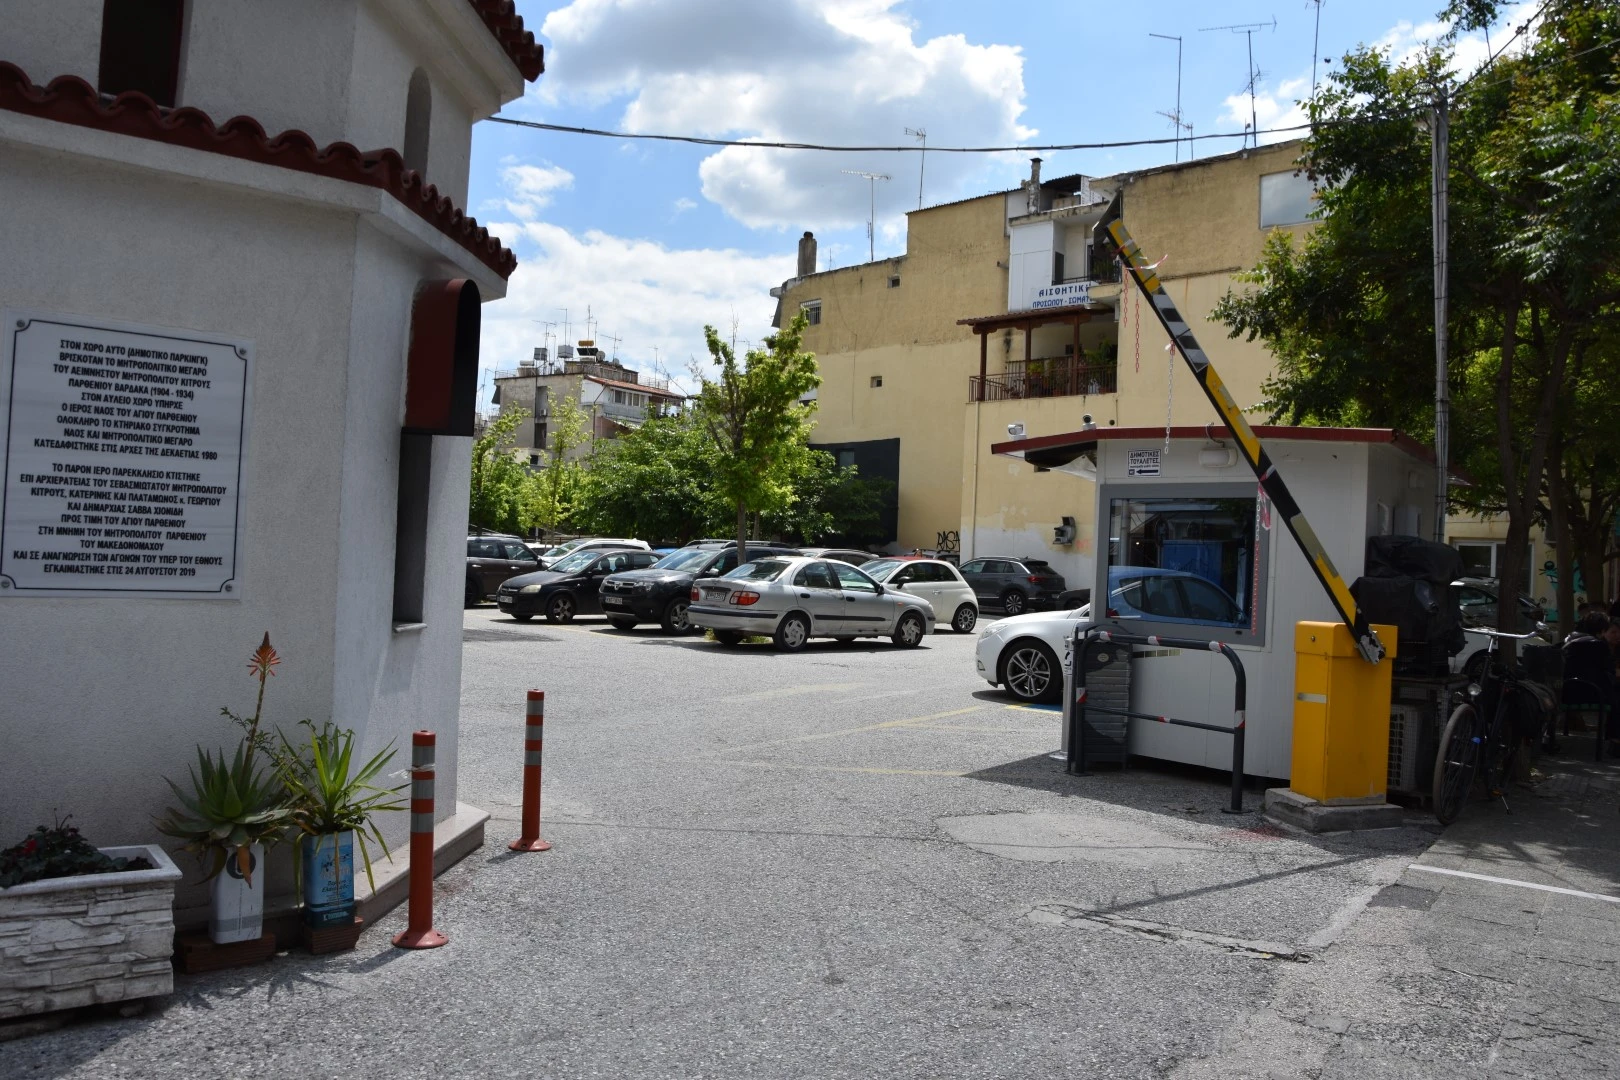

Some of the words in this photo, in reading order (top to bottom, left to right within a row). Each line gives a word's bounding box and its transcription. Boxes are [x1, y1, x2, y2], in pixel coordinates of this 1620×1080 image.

[1033, 298, 1063, 308] ΠΡΟΣΩΠΟΥ
[1068, 296, 1092, 305] ΣΩΜΑΤ
[60, 339, 82, 350] ΣΤΟΝ
[82, 342, 104, 352] ΧΩΡΟ
[105, 345, 126, 355] ΑΥΤΟ
[127, 347, 169, 360] (ΔΗΜΟΤΙΚΟ
[170, 352, 208, 365] ΠΑΡΚΙΝΓΚ)
[59, 352, 104, 365] ΒΡΙΣΚΟΤΑΝ
[105, 357, 116, 366] ΤΟ
[116, 358, 178, 373] ΜΗΤΡΟΠΟΛΙΤΙΚΟ
[178, 365, 207, 376] ΜΕΓΑΡΟ
[53, 364, 69, 374] ΤΟΥ
[70, 366, 120, 379] ΑΕΙΜΝΗΣΤΟΥ
[122, 371, 179, 385] ΜΗΤΡΟΠΟΛΙΤΟΥ
[180, 378, 211, 389] ΚΙΤΡΟΥΣ
[68, 378, 112, 390] ΠΑΡΘΕΝΙΟΥ
[114, 383, 149, 394] ΒΑΡΔΑΚΑ
[150, 387, 170, 396] (1904
[176, 389, 194, 399] 1934)
[81, 392, 102, 402] ΣΤΟΝ
[103, 394, 132, 405] ΑΥΛΕΙΟ
[132, 397, 153, 406] ΧΩΡΟ
[154, 399, 183, 409] ΥΠΗΡΧΕ
[61, 403, 68, 411] Ο
[69, 403, 92, 414] ΙΕΡΟΣ
[93, 405, 115, 416] ΝΑΟΣ
[116, 408, 131, 417] ΤΟΥ
[133, 409, 154, 419] ΑΓΙΟΥ
[156, 412, 197, 423] ΠΑΡΘΕΝΙΟΥ
[56, 415, 100, 426] ΟΛΟΚΛΗΡΟ
[102, 419, 112, 427] ΤΟ
[113, 420, 151, 431] ΚΤΗΡΙΑΚΟ
[152, 423, 200, 435] ΣΥΓΚΡΟΤΗΜΑ
[63, 428, 85, 438] ΝΑΟΣ
[86, 430, 100, 439] ΚΑΙ
[101, 431, 163, 444] ΜΗΤΡΟΠΟΛΙΤΙΚΟ
[164, 436, 193, 446] ΜΕΓΑΡΟ
[34, 438, 99, 451] ΚΑΤΕΔΑΦΙΣΤΗΚΕ
[101, 443, 118, 453] ΣΤΙΣ
[119, 445, 143, 455] ΑΡΧΕΣ
[145, 446, 159, 456] ΤΗΣ
[160, 448, 200, 458] ΔΕΚΑΕΤΙΑΣ
[201, 451, 218, 460] 1980
[52, 463, 63, 472] ΤΟ
[64, 464, 92, 474] ΠΑΡΟΝ
[93, 466, 111, 475] ΙΕΡΟ
[112, 467, 164, 479] ΠΑΡΕΚΚΛΗΣΙΟ
[166, 471, 200, 481] ΚΤΙΣΤΗΚΕ
[20, 474, 34, 483] ΕΠΙ
[36, 475, 91, 486] ΑΡΧΙΕΡΑΤΕΙΑΣ
[93, 478, 108, 487] ΤΟΥ
[110, 480, 170, 491] ΣΕΒΑΣΜΙΩΤΑΤΟΥ
[172, 484, 226, 494] ΜΗΤΡΟΠΟΛΙΤΟΥ
[68, 489, 112, 500] ΚΑΤΕΡΙΝΗΣ
[113, 492, 127, 500] ΚΑΙ
[128, 493, 178, 504] ΠΛΑΤΑΜΩΝΟΣ
[187, 496, 220, 506] ΓΕΩΡΓΙΟΥ
[67, 502, 81, 511] ΚΑΙ
[83, 503, 126, 513] ΔΗΜΑΡΧΙΑΣ
[128, 505, 152, 514] ΣΑΒΒΑ
[154, 506, 184, 516] ΧΙΟΝΙΔΗ
[60, 514, 81, 523] ΠΡΟΣ
[84, 515, 103, 524] ΤΙΜΗ
[104, 516, 119, 524] ΤΟΥ
[121, 517, 143, 526] ΑΓΙΟΥ
[144, 518, 186, 528] ΠΑΡΘΕΝΙΟΥ
[38, 526, 54, 535] ΣΤΗ
[56, 527, 86, 536] ΜΝΗΜΗ
[87, 528, 102, 536] ΤΟΥ
[104, 529, 162, 539] ΜΗΤΡΟΠΟΛΙΤΟΥ
[166, 531, 206, 541] ΠΑΡΘΕΝΙΟΥ
[80, 540, 95, 548] ΤΟΥ
[97, 541, 164, 550] ΜΑΚΕΔΟΝΟΜΑΧΟΥ
[13, 551, 28, 559] ΚΑΙ
[29, 551, 40, 560] ΣΕ
[41, 551, 92, 561] ΑΝΑΓΝΩΡΙΣΗ
[92, 553, 109, 562] ΤΩΝ
[110, 554, 141, 562] ΑΓΩΝΩΝ
[142, 554, 157, 563] ΤΟΥ
[158, 555, 178, 563] ΥΠΕΡ
[179, 556, 193, 564] ΤΟΥ
[194, 556, 223, 565] ΕΘΝΟΥΣ
[43, 564, 105, 574] ΕΓΚΑΙΝΙΑΣΤΗΚΕ
[106, 565, 124, 574] ΣΤΙΣ
[124, 566, 134, 574] 24
[135, 566, 177, 575] ΑΥΓΟΥΣΤΟΥ
[179, 568, 196, 576] 2019
